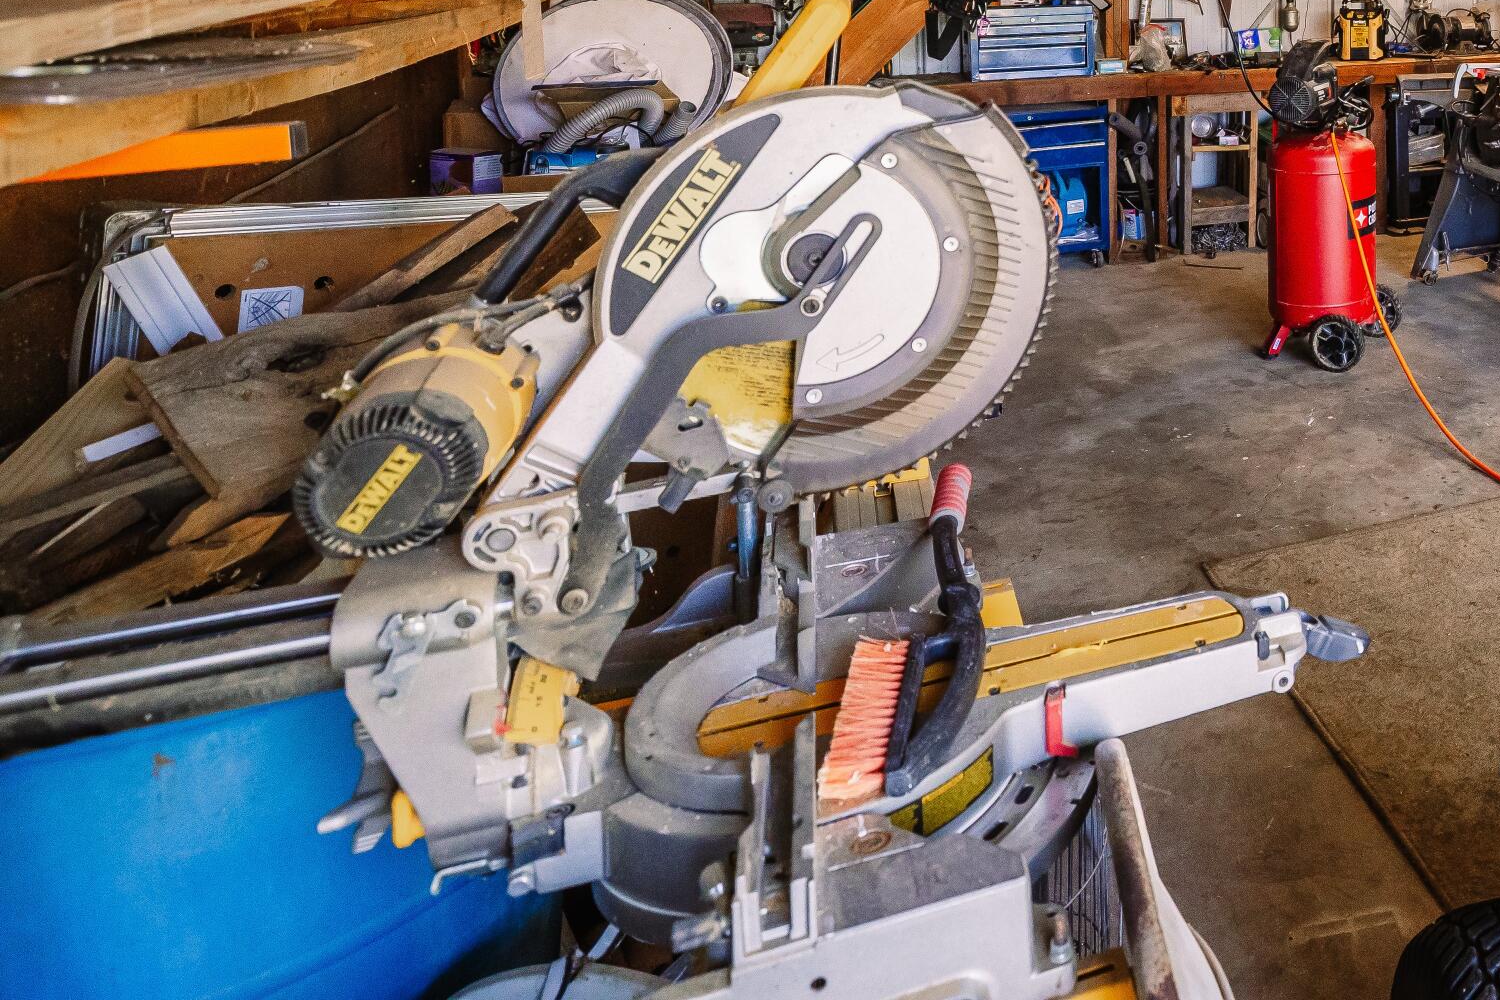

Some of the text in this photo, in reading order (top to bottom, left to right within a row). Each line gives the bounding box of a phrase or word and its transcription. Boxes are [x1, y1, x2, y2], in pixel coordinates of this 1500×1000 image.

[1244, 38, 1255, 46] XL
[625, 149, 741, 284] DEWALT
[335, 443, 424, 535] DEWALT
